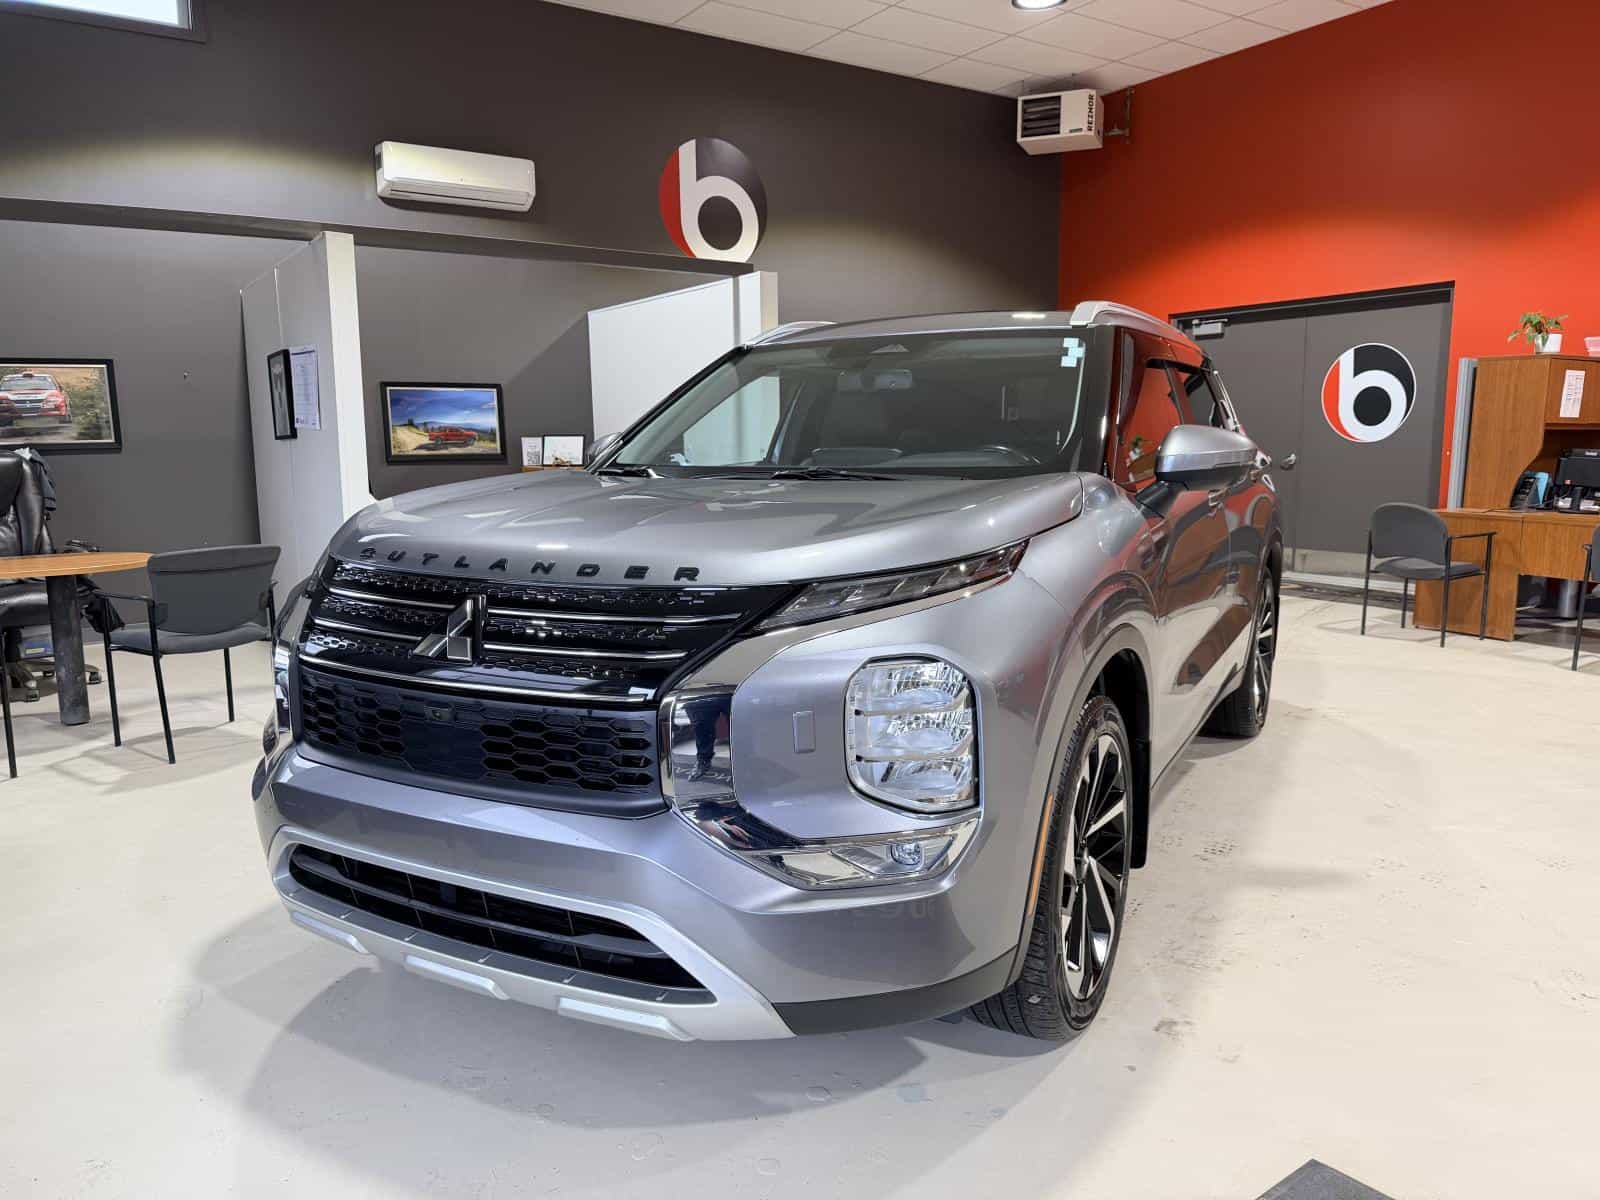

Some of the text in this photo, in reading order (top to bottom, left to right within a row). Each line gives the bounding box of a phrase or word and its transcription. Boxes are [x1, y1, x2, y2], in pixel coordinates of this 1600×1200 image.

[1087, 94, 1095, 132] REZNOR
[679, 138, 759, 263] b
[1338, 347, 1407, 442] b
[359, 547, 700, 582] OUTLANDER
